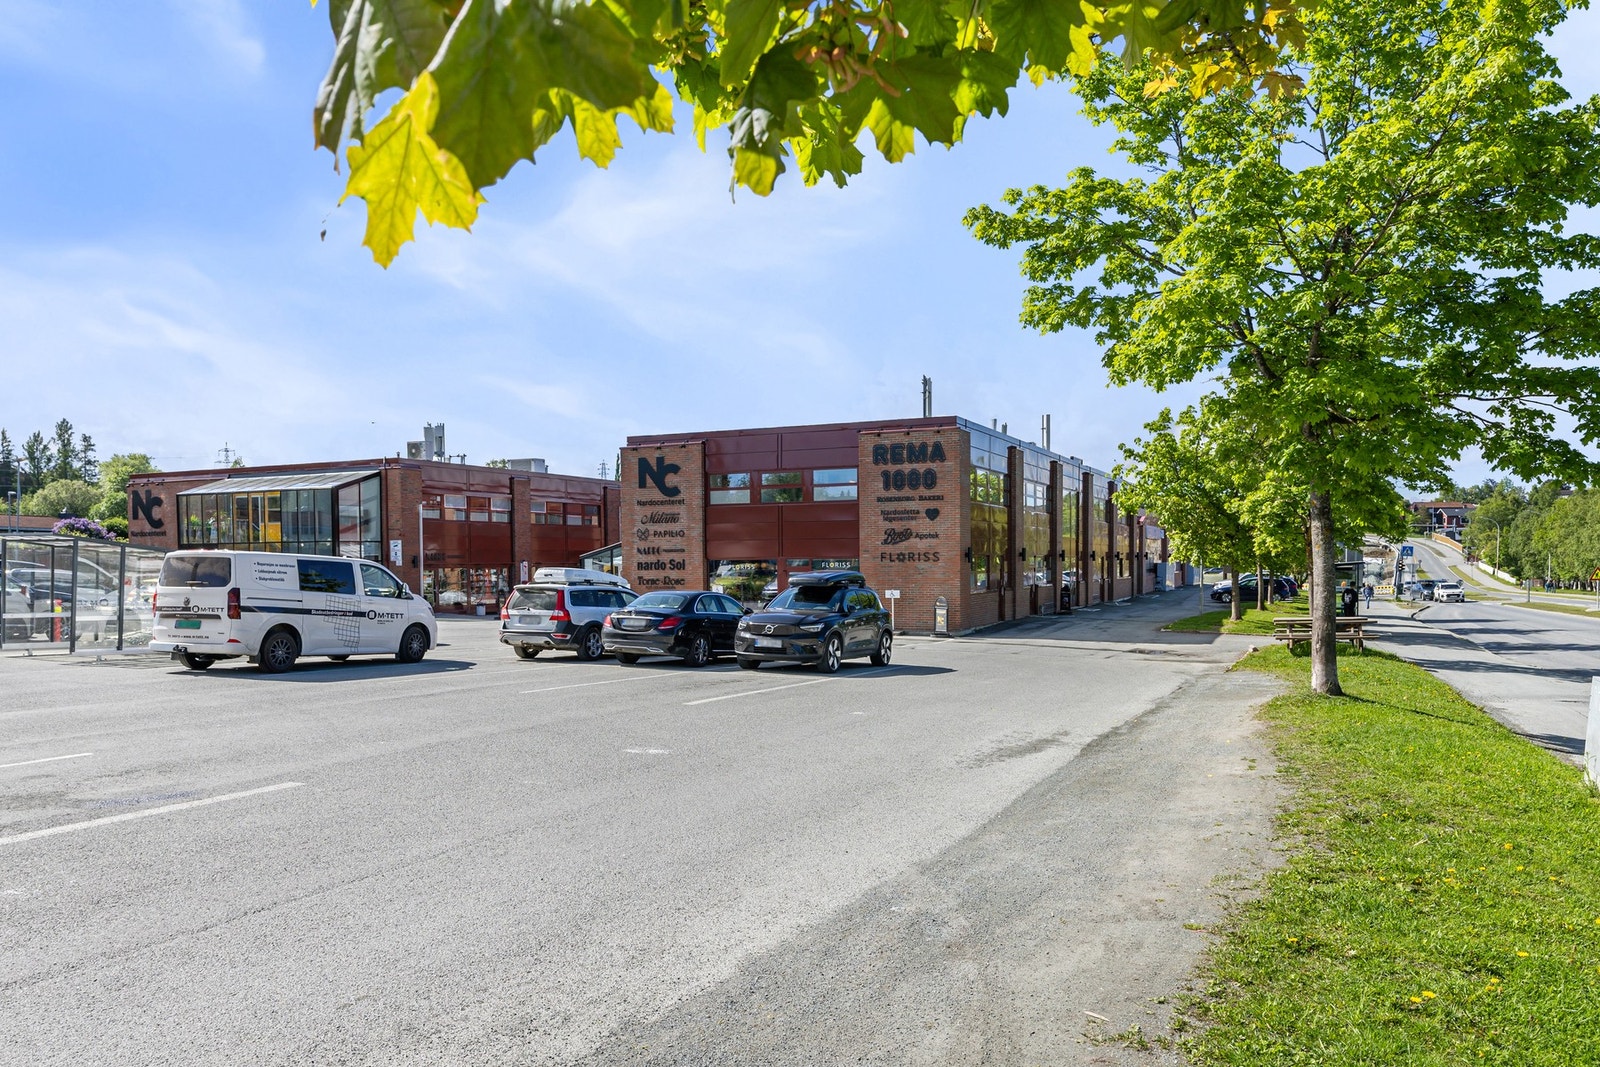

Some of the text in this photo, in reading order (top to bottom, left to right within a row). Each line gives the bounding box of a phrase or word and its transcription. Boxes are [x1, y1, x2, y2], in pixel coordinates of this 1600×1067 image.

[872, 441, 946, 466] REMA
[881, 468, 937, 491] 1000
[641, 511, 680, 524] Milano
[653, 530, 686, 538] PAPILIO
[914, 532, 940, 540] Apotek
[881, 552, 940, 562] FLORISS
[637, 559, 686, 571] nardo Sol
[821, 561, 851, 569] FLORISS
